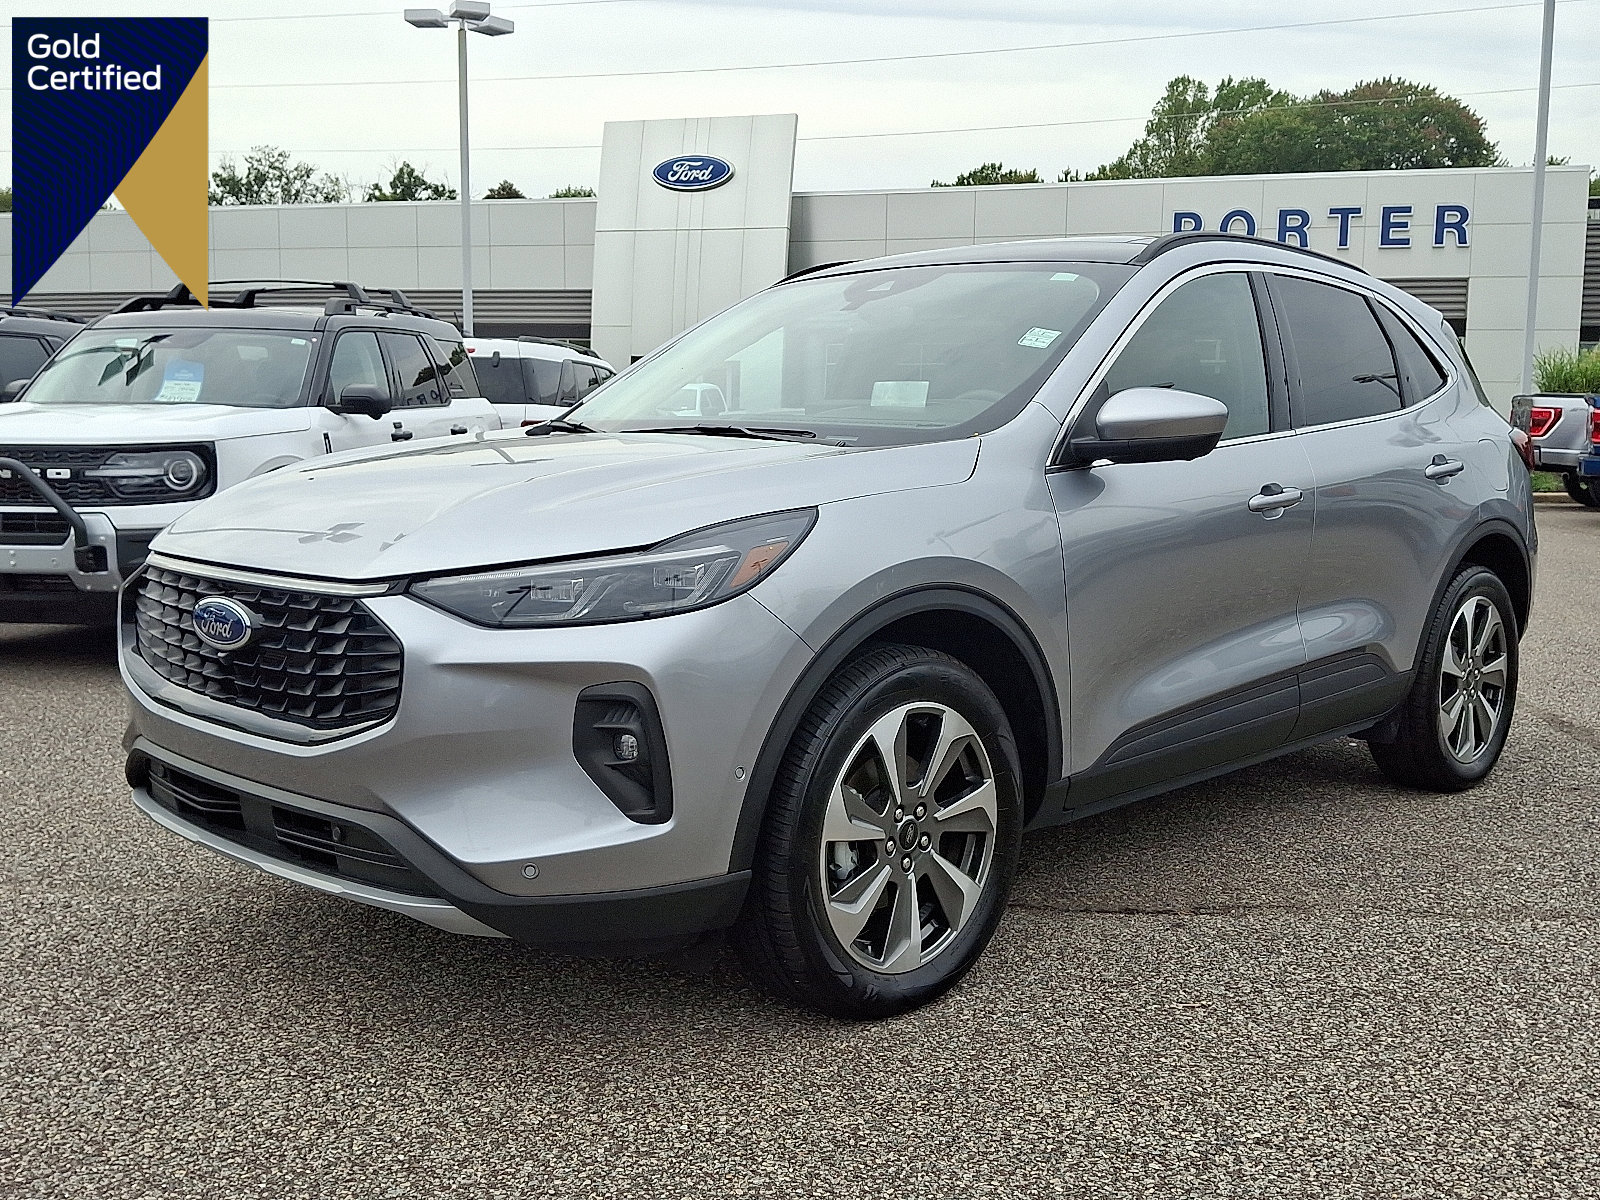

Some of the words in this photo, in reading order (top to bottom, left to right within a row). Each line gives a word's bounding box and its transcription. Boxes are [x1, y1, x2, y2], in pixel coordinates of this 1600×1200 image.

[667, 160, 714, 182] Ford
[1172, 203, 1471, 249] PORTER
[201, 607, 234, 638] Ford
